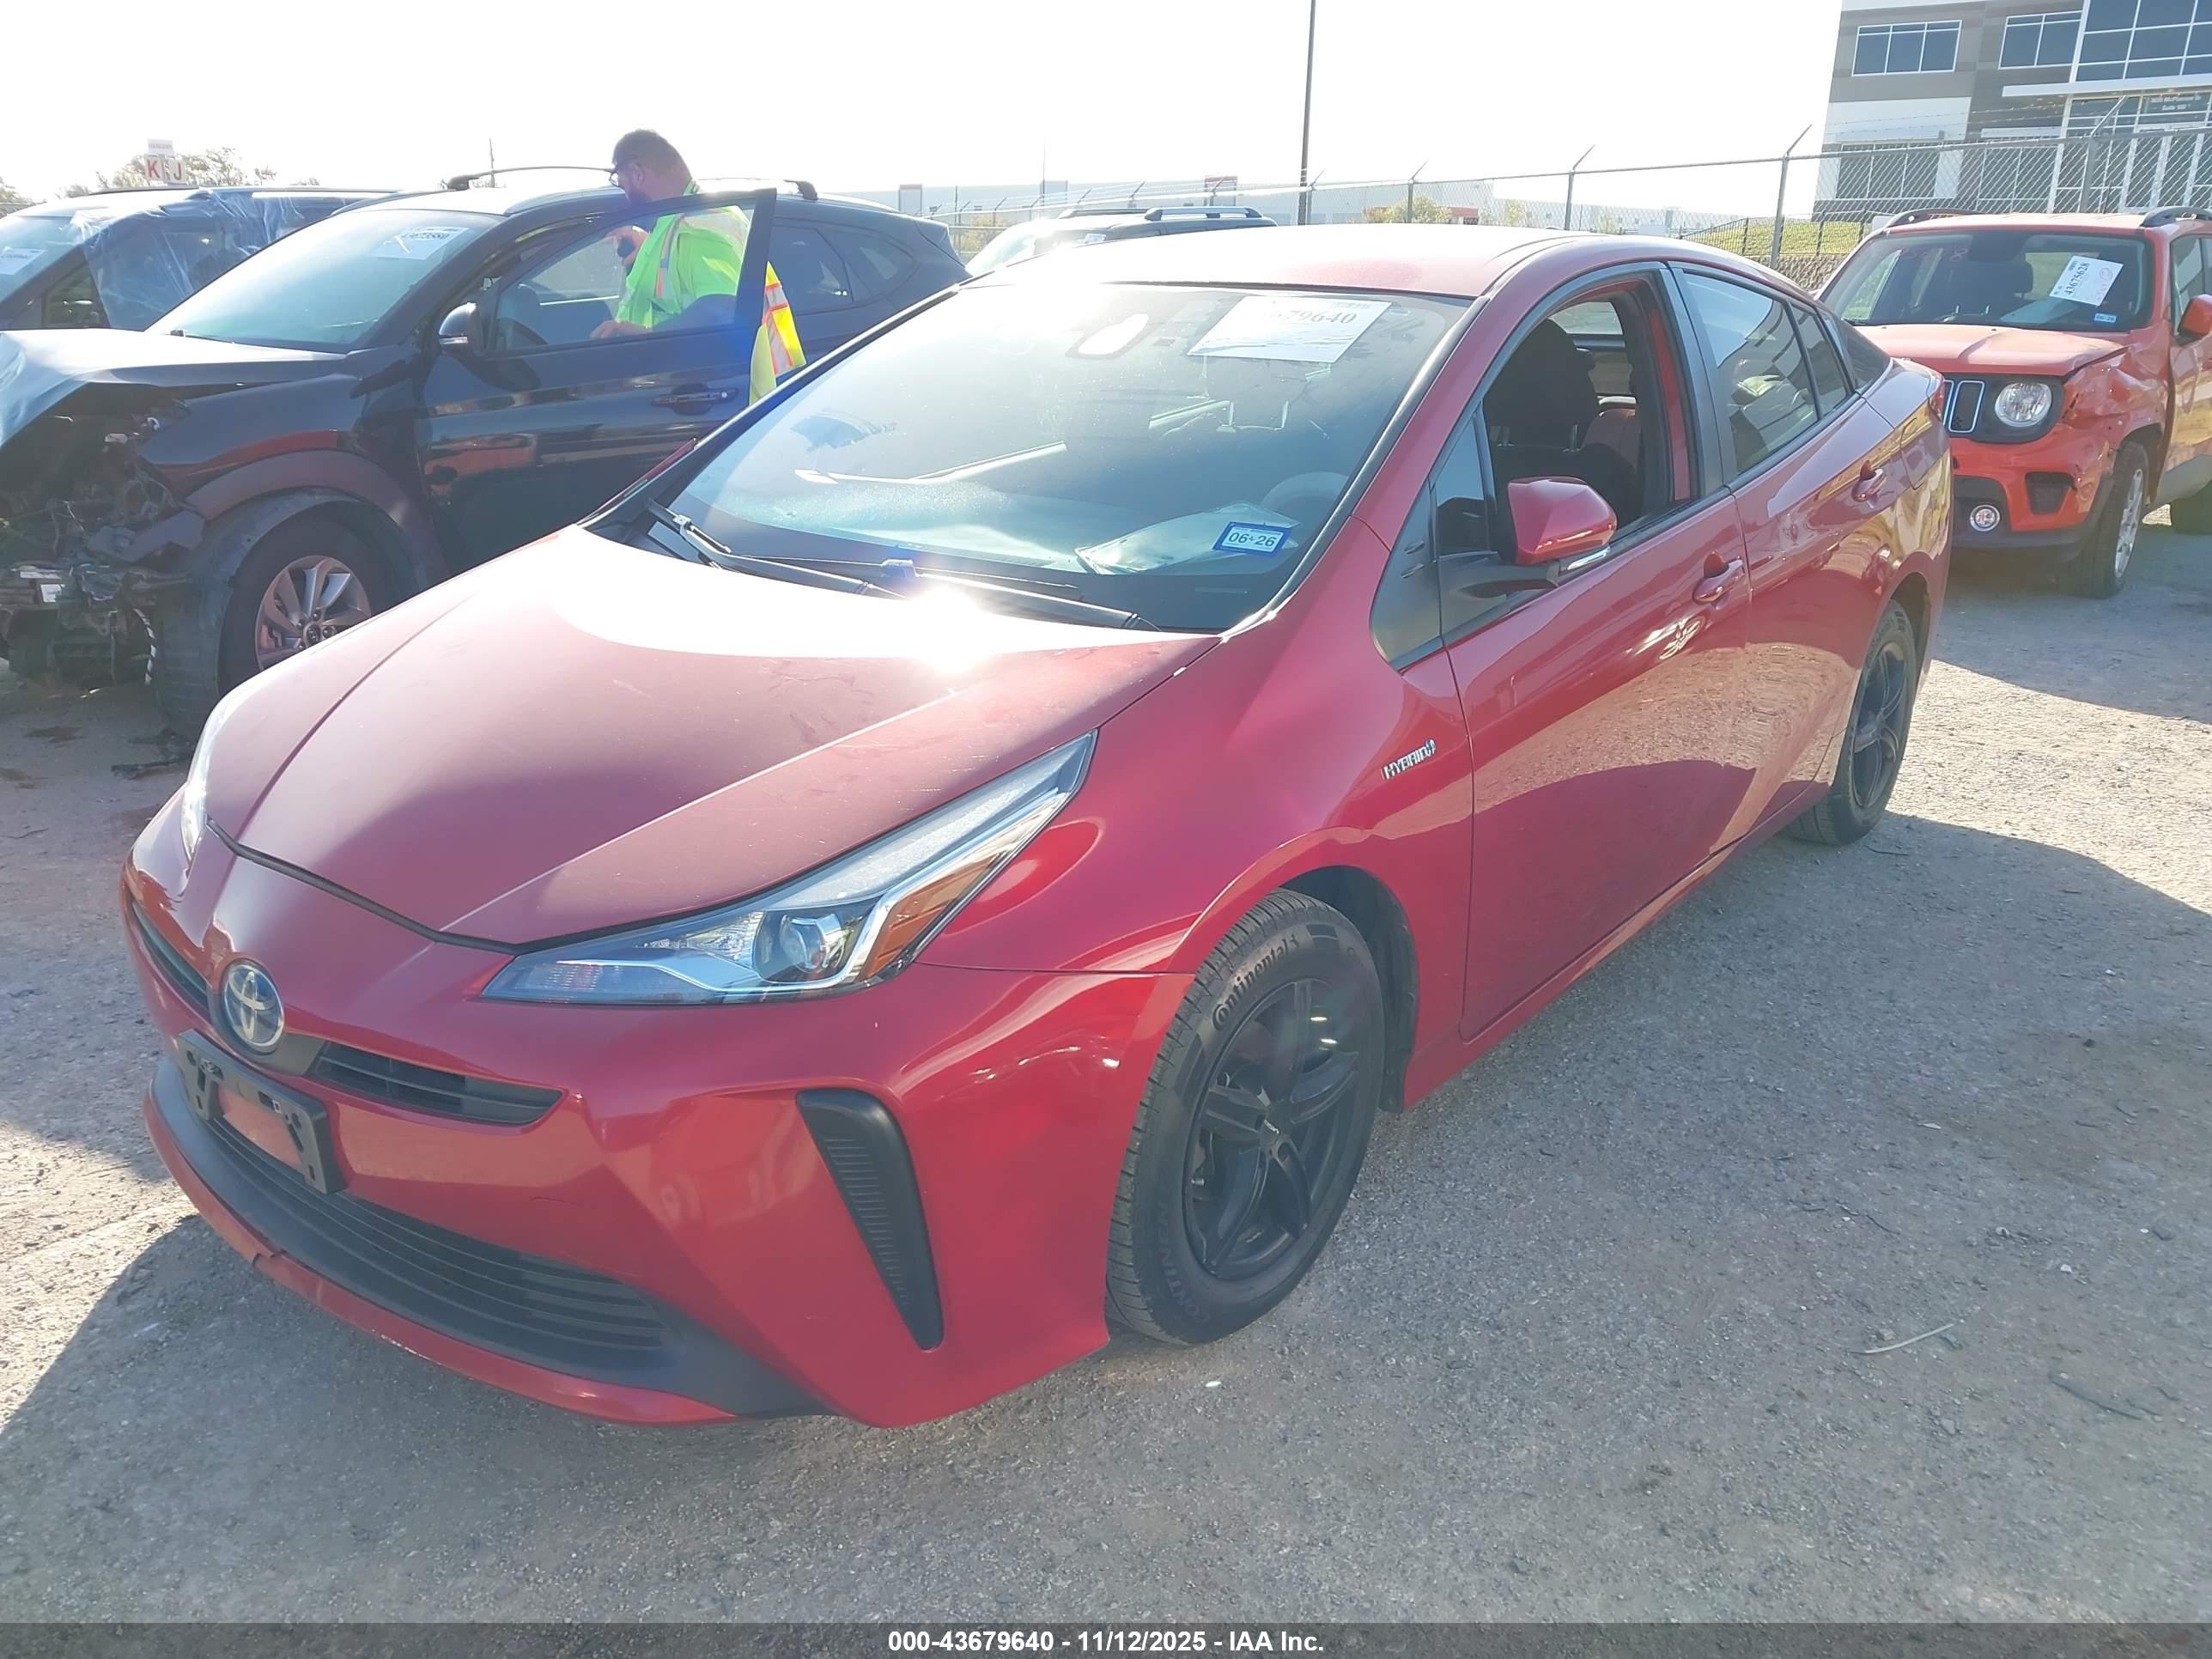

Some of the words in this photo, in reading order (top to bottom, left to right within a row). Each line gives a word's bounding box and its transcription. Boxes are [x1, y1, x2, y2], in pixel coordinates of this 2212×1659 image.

[147, 159, 161, 179] K
[173, 162, 181, 180] J
[2064, 261, 2090, 295] 43675628
[1228, 532, 1250, 544] 06
[1255, 535, 1277, 547] 26
[1382, 745, 1431, 780] HYBRID
[1212, 937, 1290, 1030] Continental
